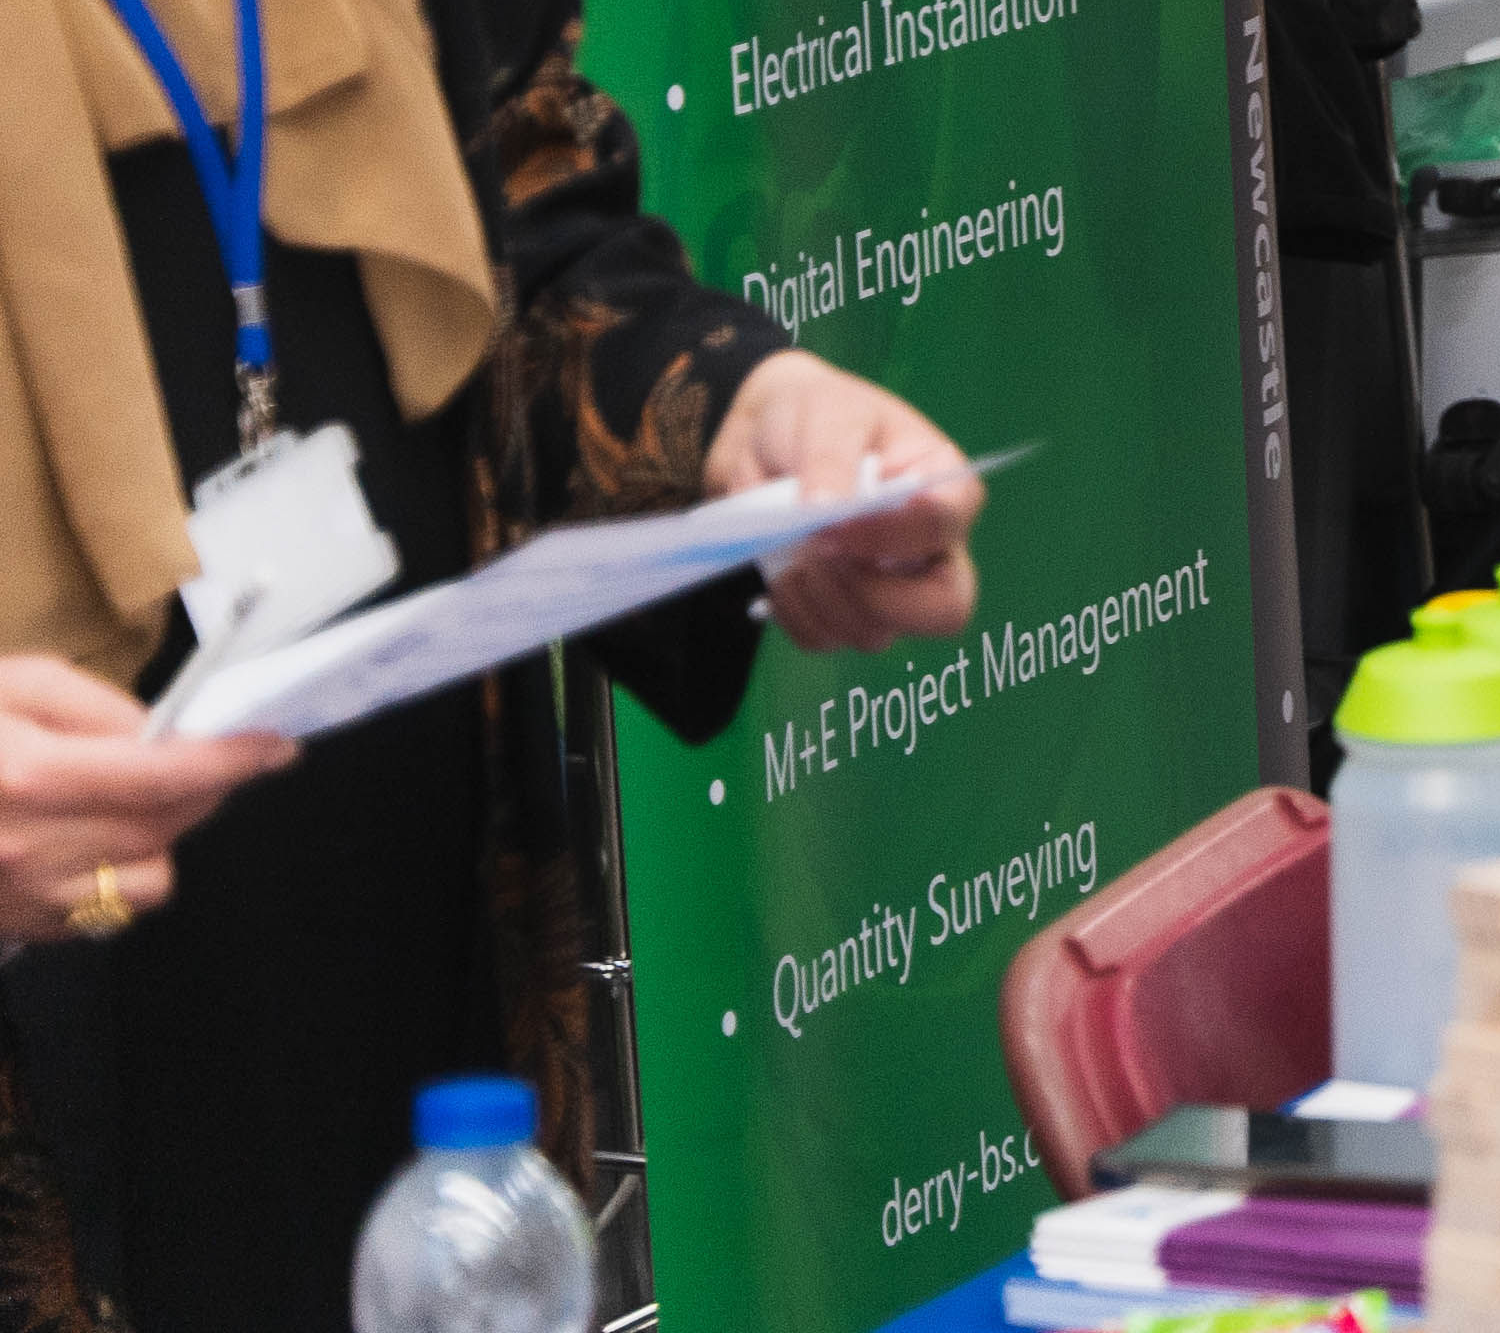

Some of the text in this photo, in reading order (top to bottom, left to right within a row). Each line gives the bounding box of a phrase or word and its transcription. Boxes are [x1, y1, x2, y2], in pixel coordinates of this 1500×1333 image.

[730, 0, 872, 119] Electrical
[743, 180, 1065, 344] Digital Engineering
[1242, 15, 1287, 481] Newcastle
[762, 547, 1211, 805] M+E Project Management
[773, 818, 1100, 1039] Quantity Surveying
